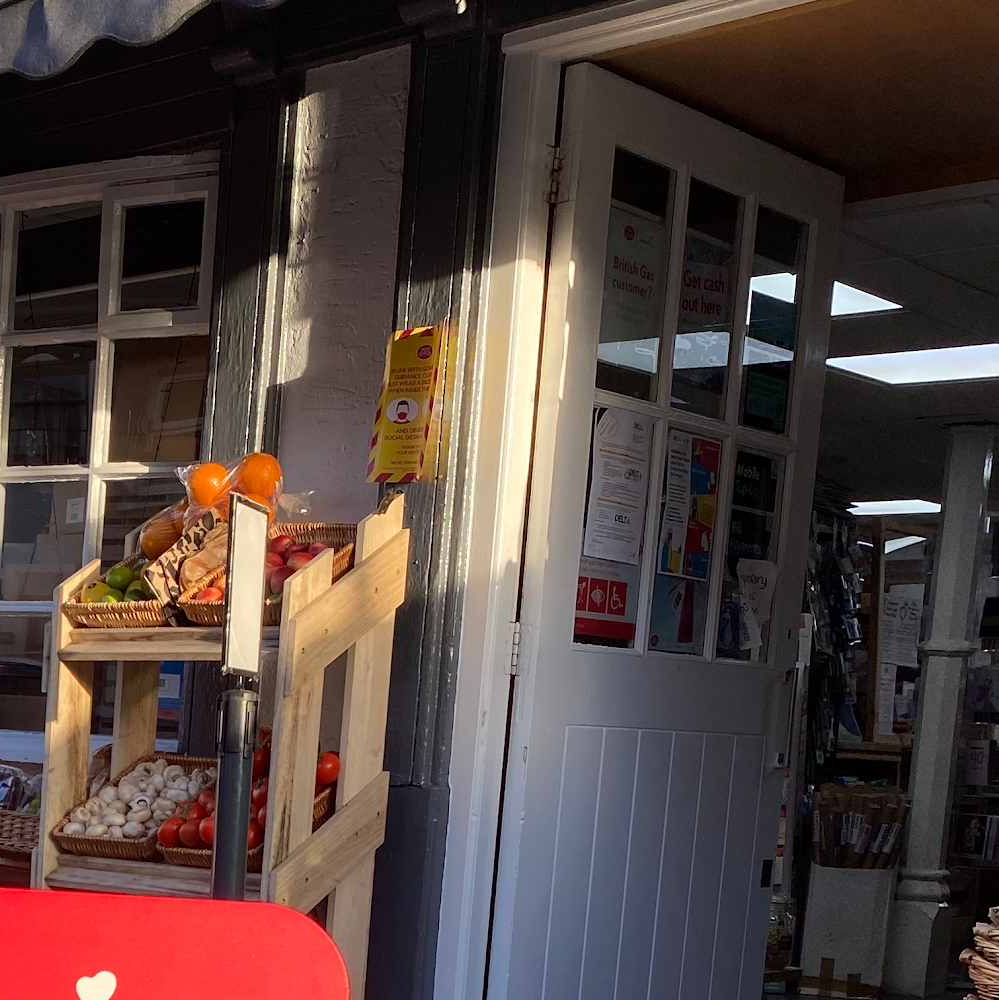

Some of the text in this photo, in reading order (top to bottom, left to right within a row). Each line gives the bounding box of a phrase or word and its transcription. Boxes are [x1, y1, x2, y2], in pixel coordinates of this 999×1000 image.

[613, 255, 655, 281] British Gas
[612, 278, 653, 299] customer?
[683, 269, 725, 293] Get cash
[682, 294, 722, 316] out here
[736, 463, 760, 480] Mobile
[615, 514, 631, 525] DELTA
[732, 520, 743, 534] Bill
[730, 537, 762, 556] Payments
